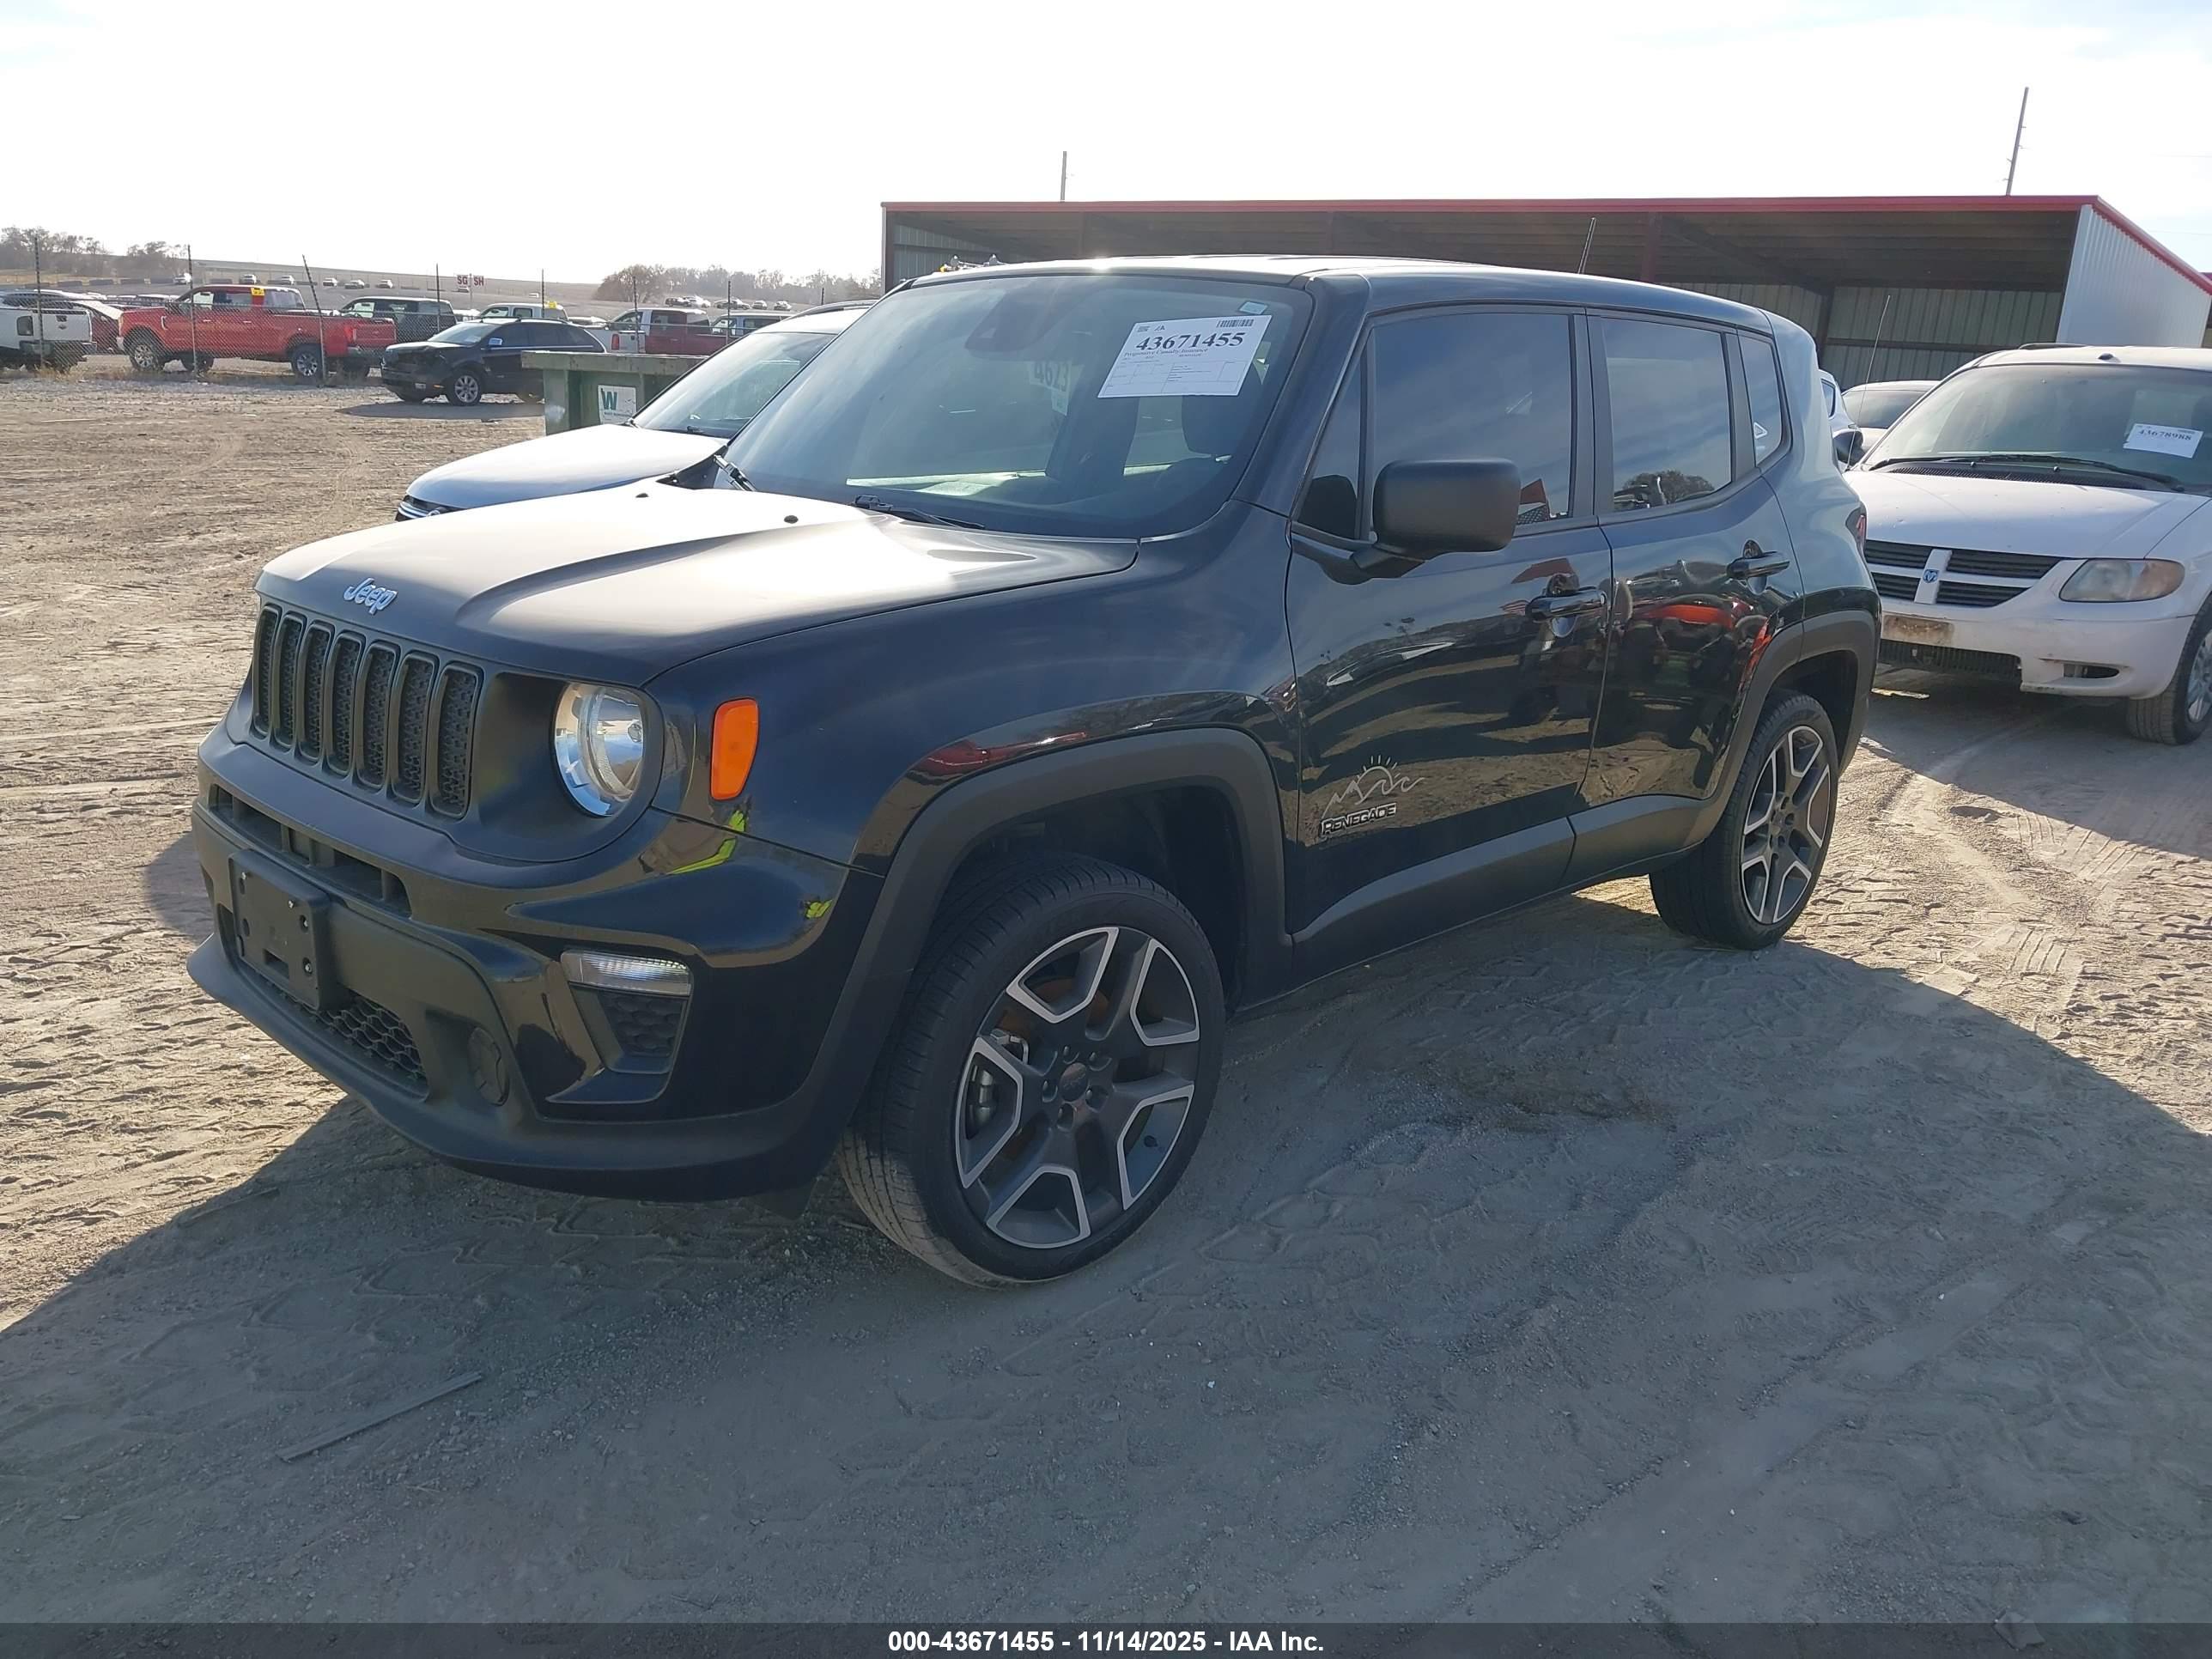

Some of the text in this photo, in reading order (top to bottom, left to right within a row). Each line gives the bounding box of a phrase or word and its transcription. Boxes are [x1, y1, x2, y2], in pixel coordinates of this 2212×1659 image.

[457, 275, 468, 284] SG
[473, 276, 484, 286] SH
[1136, 331, 1246, 351] 43671455
[343, 577, 398, 615] Jeep
[1321, 801, 1397, 836] RENEGADE
